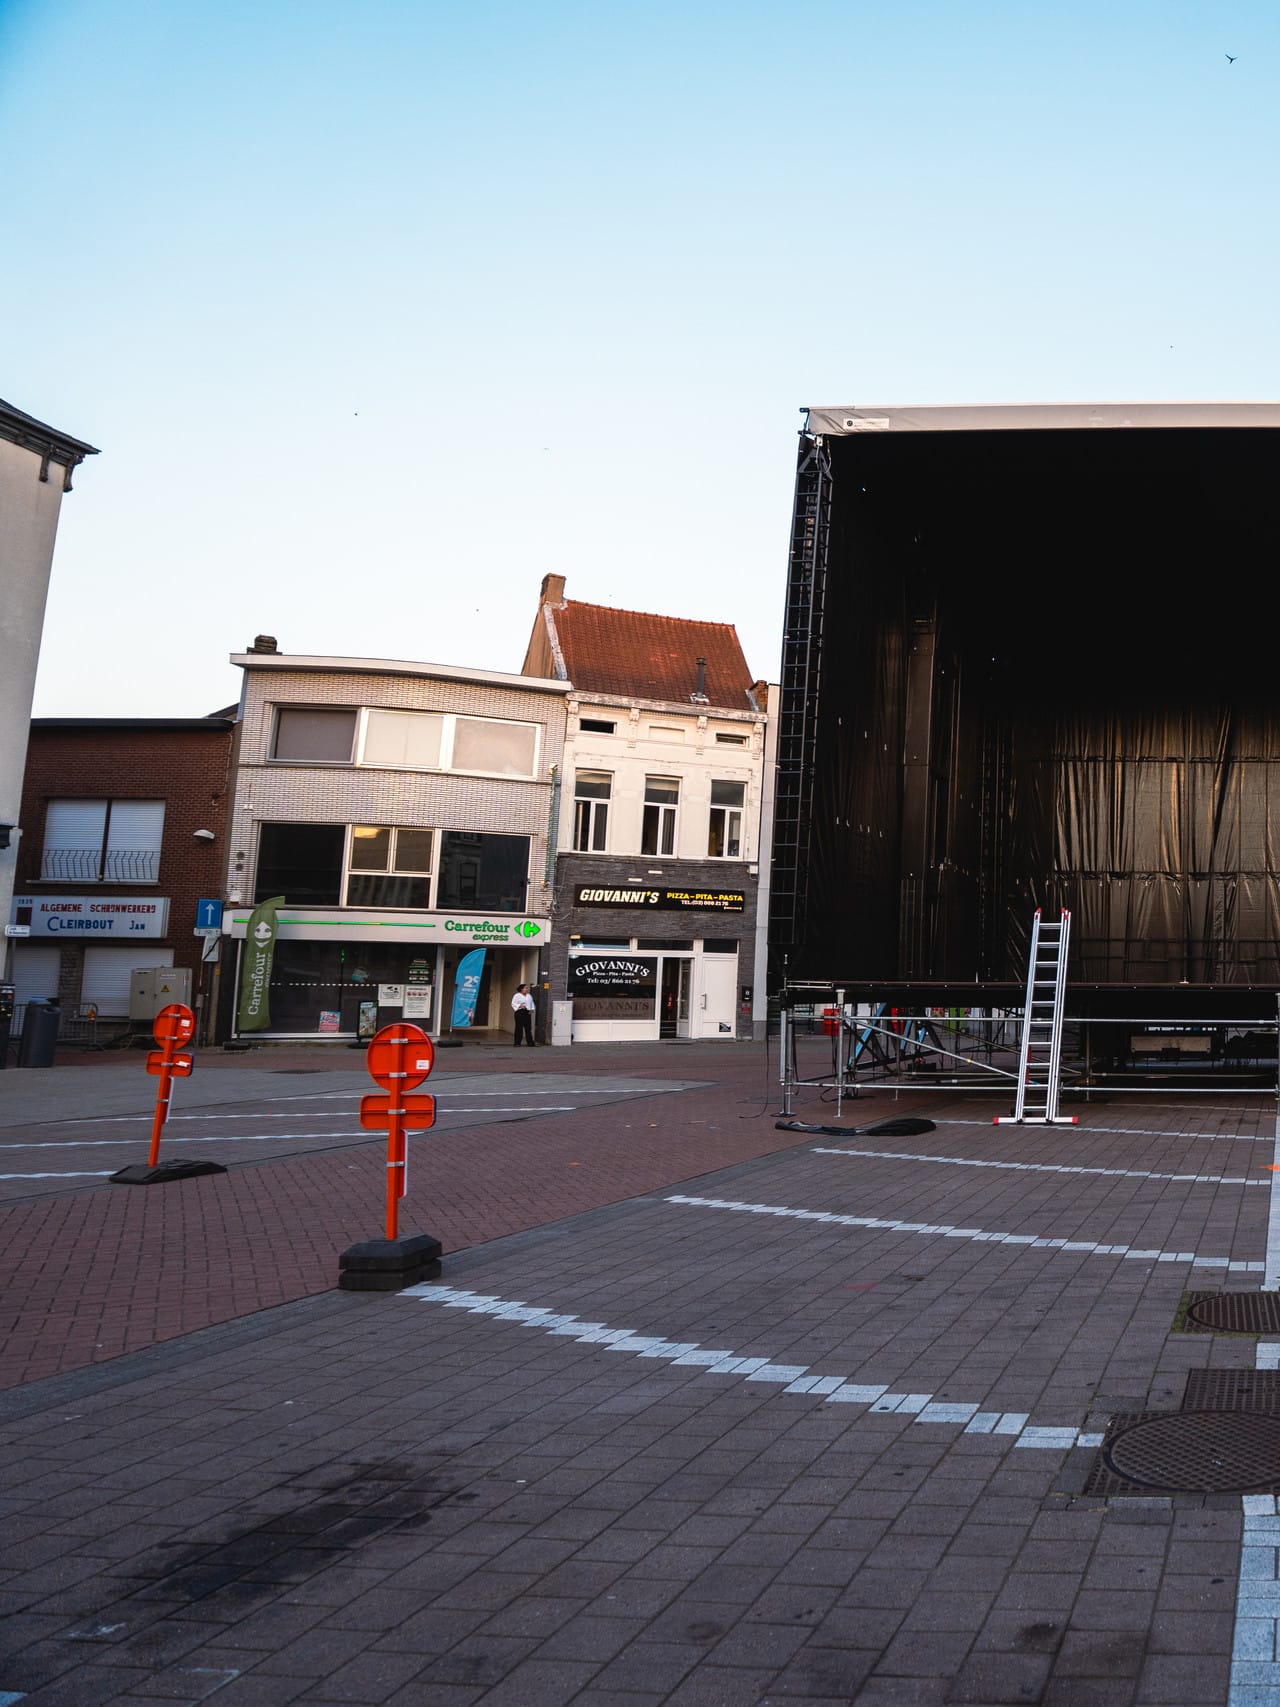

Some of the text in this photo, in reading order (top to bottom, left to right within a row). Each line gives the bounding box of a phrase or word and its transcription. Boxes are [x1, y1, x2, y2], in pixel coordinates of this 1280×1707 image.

[579, 889, 660, 904] GIOVANNI'S
[666, 892, 690, 900] PIZZA
[695, 893, 713, 901] PITA
[719, 894, 743, 902] PASTA
[40, 903, 83, 913] ALGEMENE
[47, 916, 114, 931] CLEIRBOUT
[444, 919, 511, 933] Carrefour
[472, 934, 510, 942] express
[575, 960, 651, 977] GIOVANNI'S
[247, 952, 266, 1015] Carrefour
